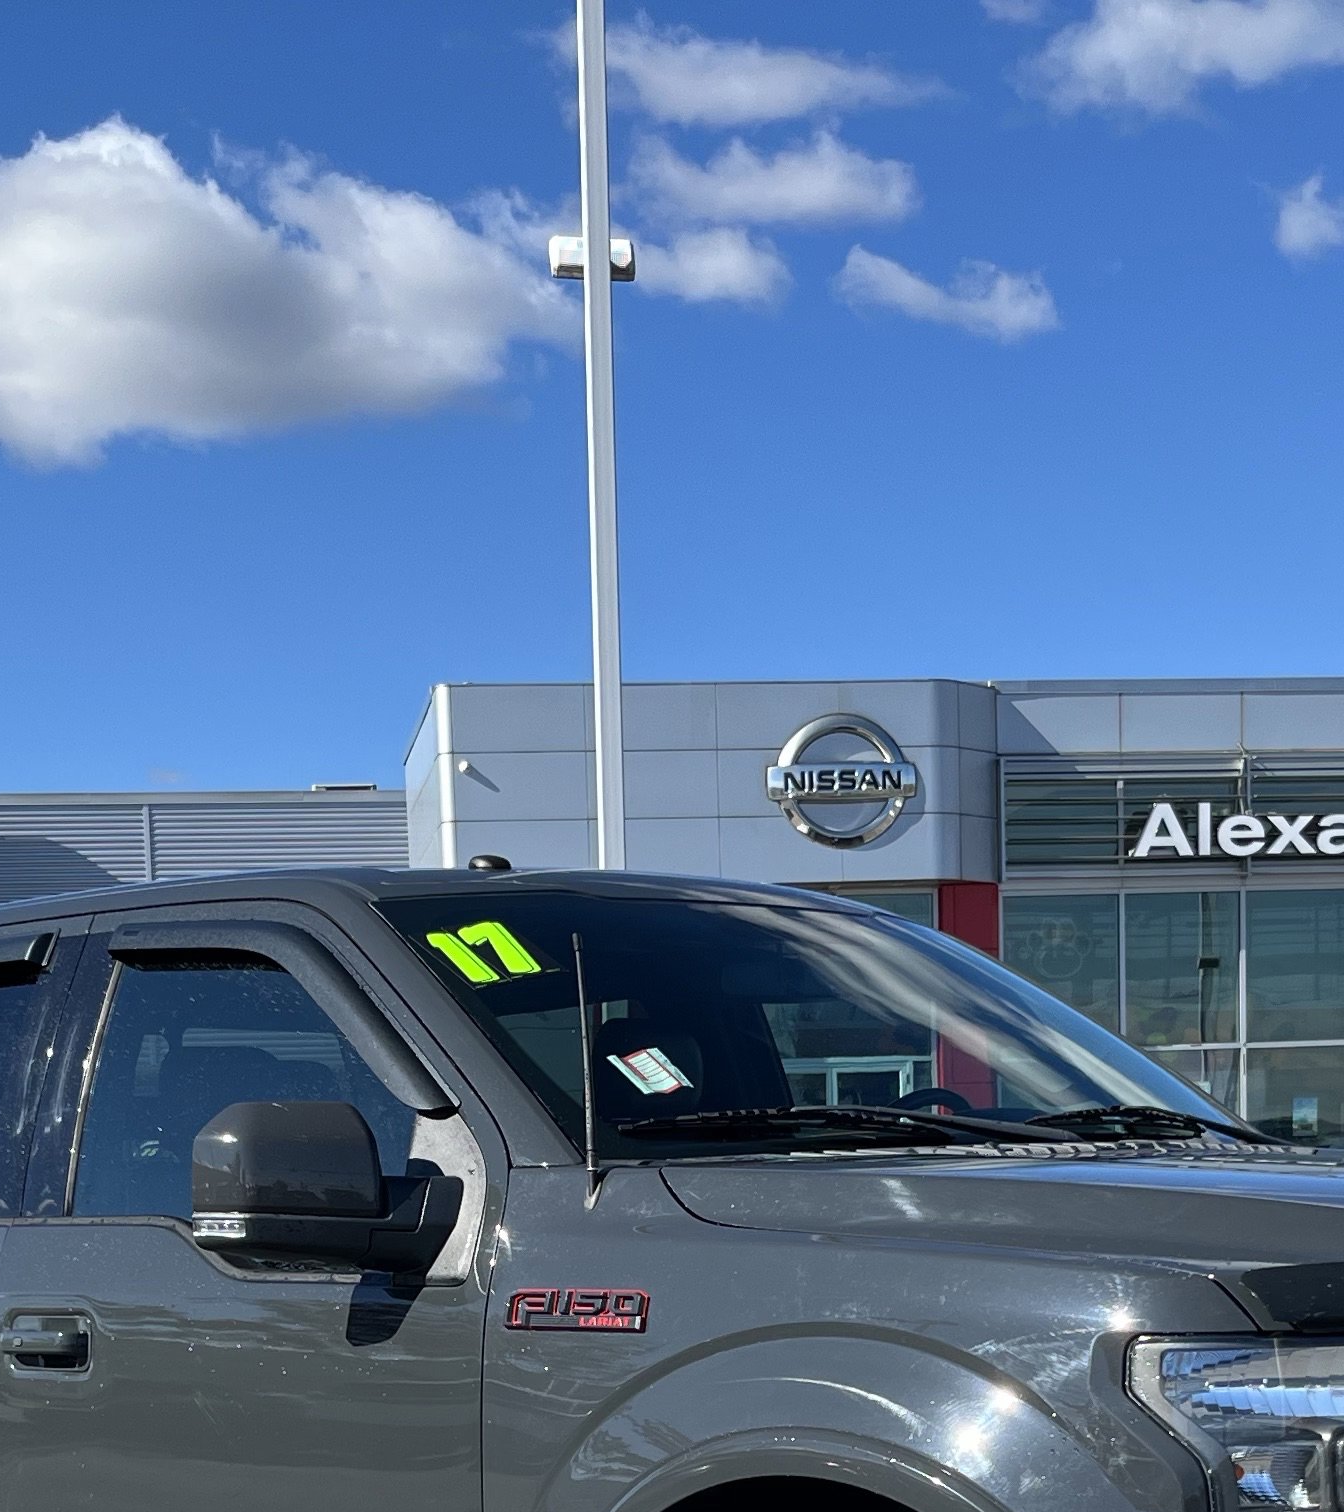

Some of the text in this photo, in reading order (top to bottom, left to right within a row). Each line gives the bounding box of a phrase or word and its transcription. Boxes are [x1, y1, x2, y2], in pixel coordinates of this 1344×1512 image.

[783, 769, 903, 792] NISSAN
[426, 922, 542, 983] 17
[578, 1316, 630, 1327] LARIAT
